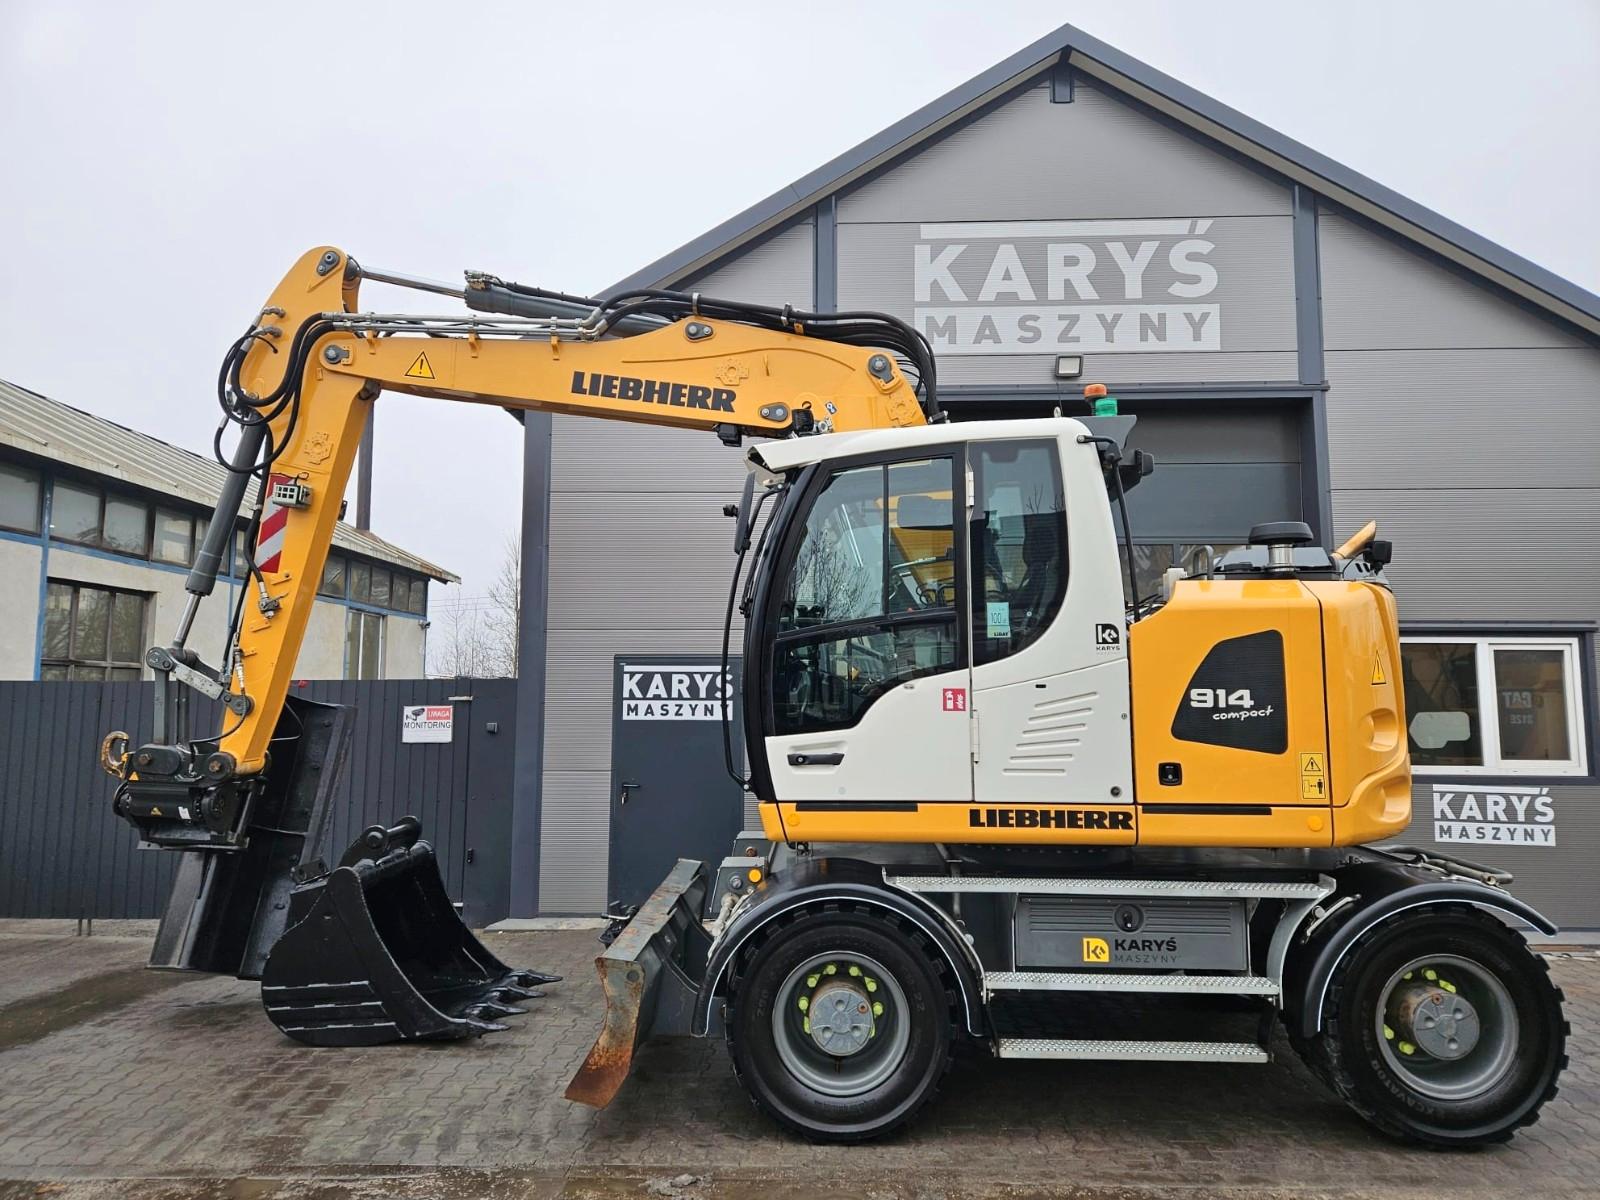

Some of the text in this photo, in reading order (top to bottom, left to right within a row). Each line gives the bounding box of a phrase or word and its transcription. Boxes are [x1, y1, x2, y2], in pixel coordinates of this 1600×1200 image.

[914, 220, 1219, 301] KARYŚ
[925, 312, 1212, 344] MASZYNY
[571, 371, 737, 413] LIEBHERR
[623, 665, 733, 699] KARYŚ
[1190, 688, 1255, 709] 914
[1212, 705, 1274, 721] compact
[404, 721, 451, 729] MONITORING
[1433, 787, 1555, 823] KARYŚ
[969, 808, 1135, 830] LIEBHERR
[1439, 825, 1551, 842] MASZYNY
[1114, 936, 1178, 951] KARYŚ
[1115, 954, 1178, 963] MASZYNY
